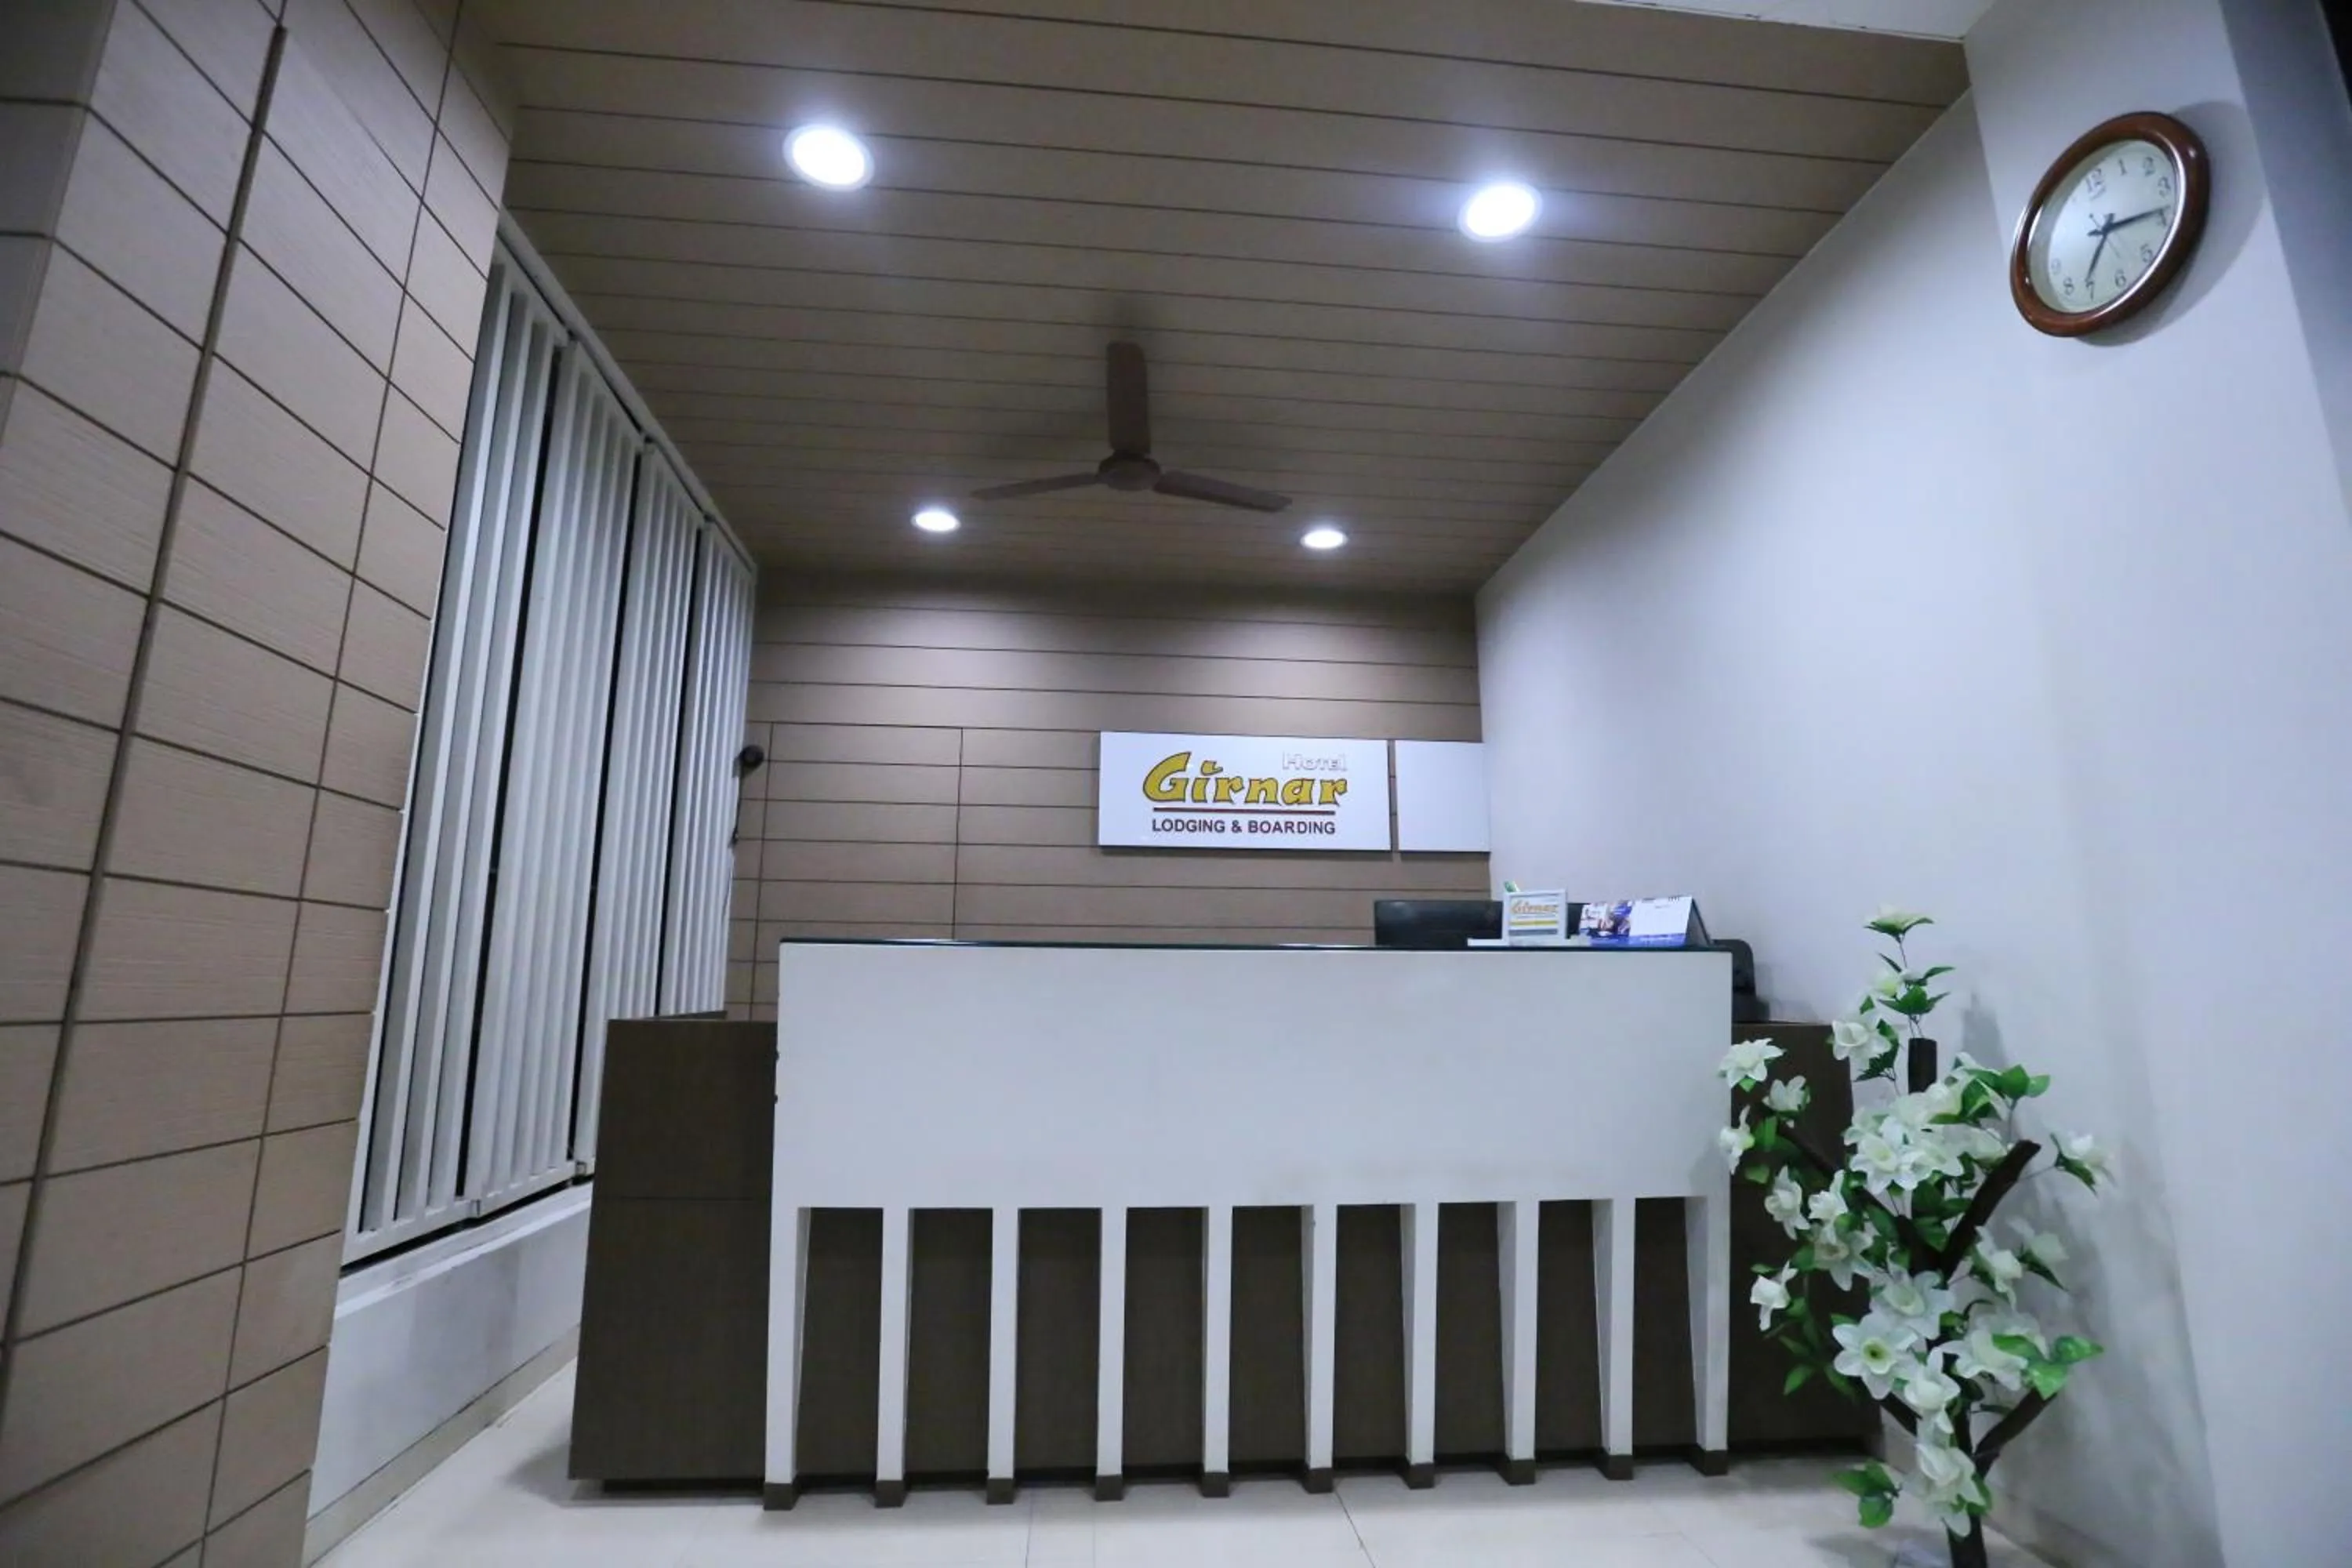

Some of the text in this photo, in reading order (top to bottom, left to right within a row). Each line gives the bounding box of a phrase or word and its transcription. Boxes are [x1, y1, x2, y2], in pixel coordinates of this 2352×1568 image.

[2118, 159, 2128, 176] 1
[2142, 157, 2154, 177] 2
[2158, 177, 2171, 197] 3
[2140, 243, 2154, 263] 5
[2063, 277, 2074, 296] 8
[2114, 270, 2127, 289] 6
[1142, 751, 1348, 807] Girnar
[1152, 818, 1335, 834] LODGING & BOARDING
